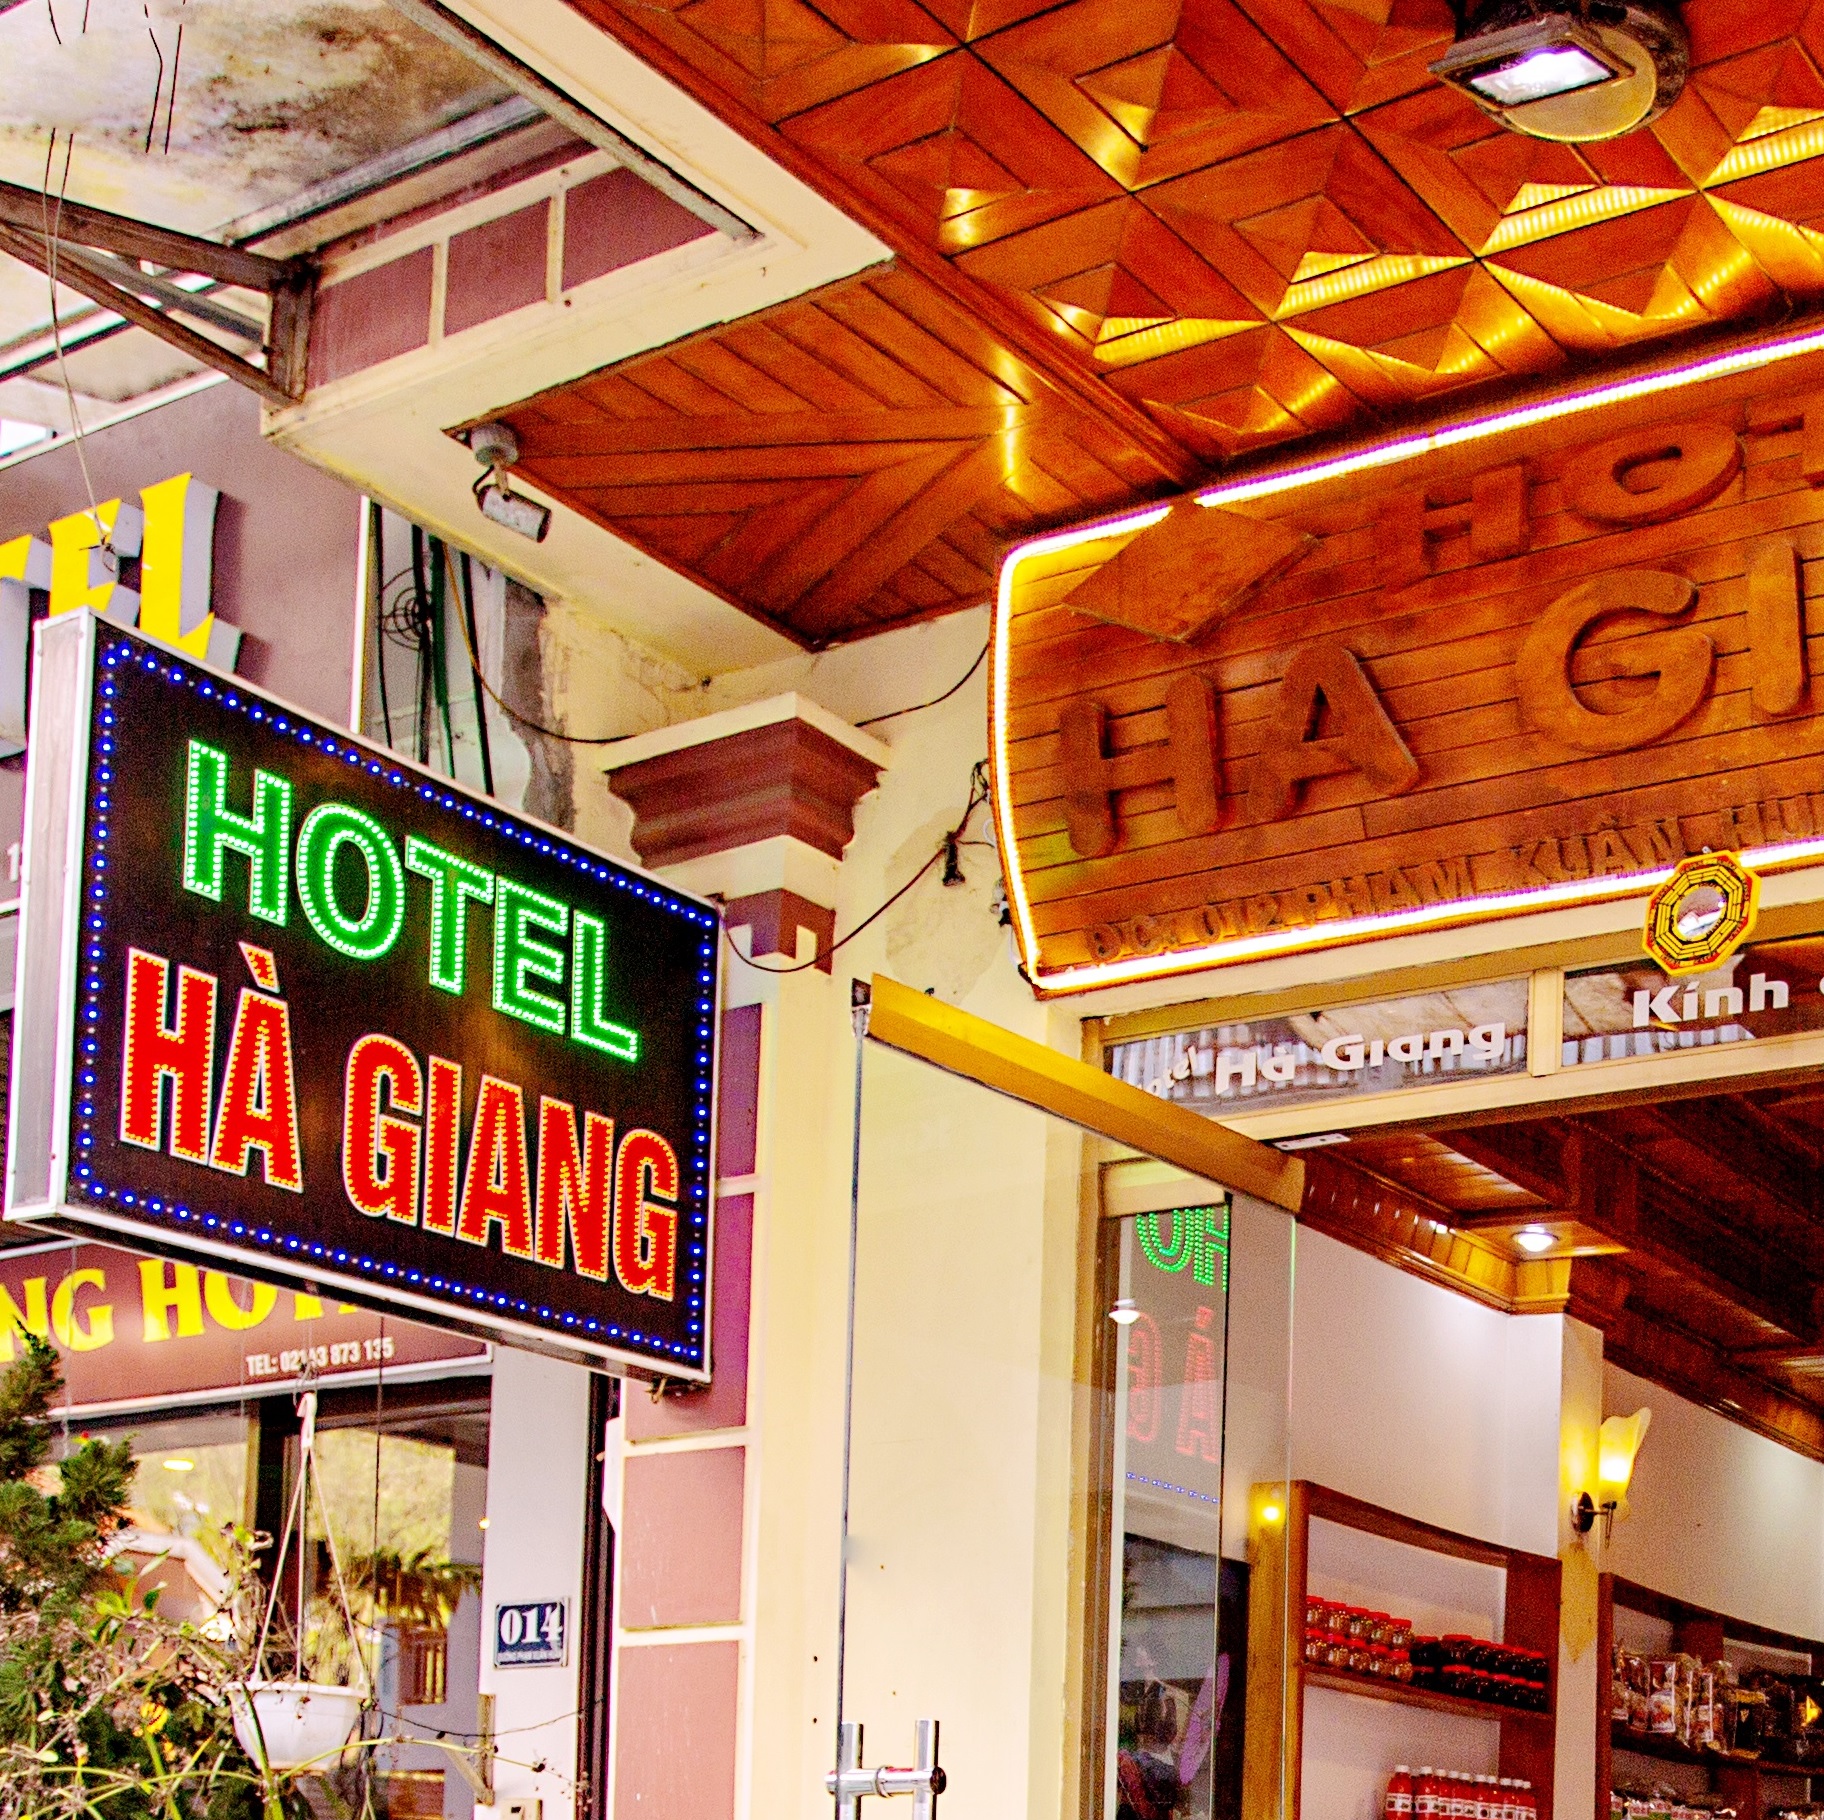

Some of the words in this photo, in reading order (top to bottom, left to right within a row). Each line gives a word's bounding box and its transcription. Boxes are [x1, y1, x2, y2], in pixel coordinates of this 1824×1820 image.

[181, 739, 640, 1064] HOTEL
[1632, 973, 1790, 1029] Kính
[1138, 1045, 1197, 1096] otel
[118, 940, 304, 1194] HÀ
[341, 1032, 680, 1301] GIANG
[246, 1353, 279, 1377] TEL:
[329, 1340, 361, 1366] 873
[363, 1336, 396, 1361] 135
[500, 1605, 563, 1646] 014
